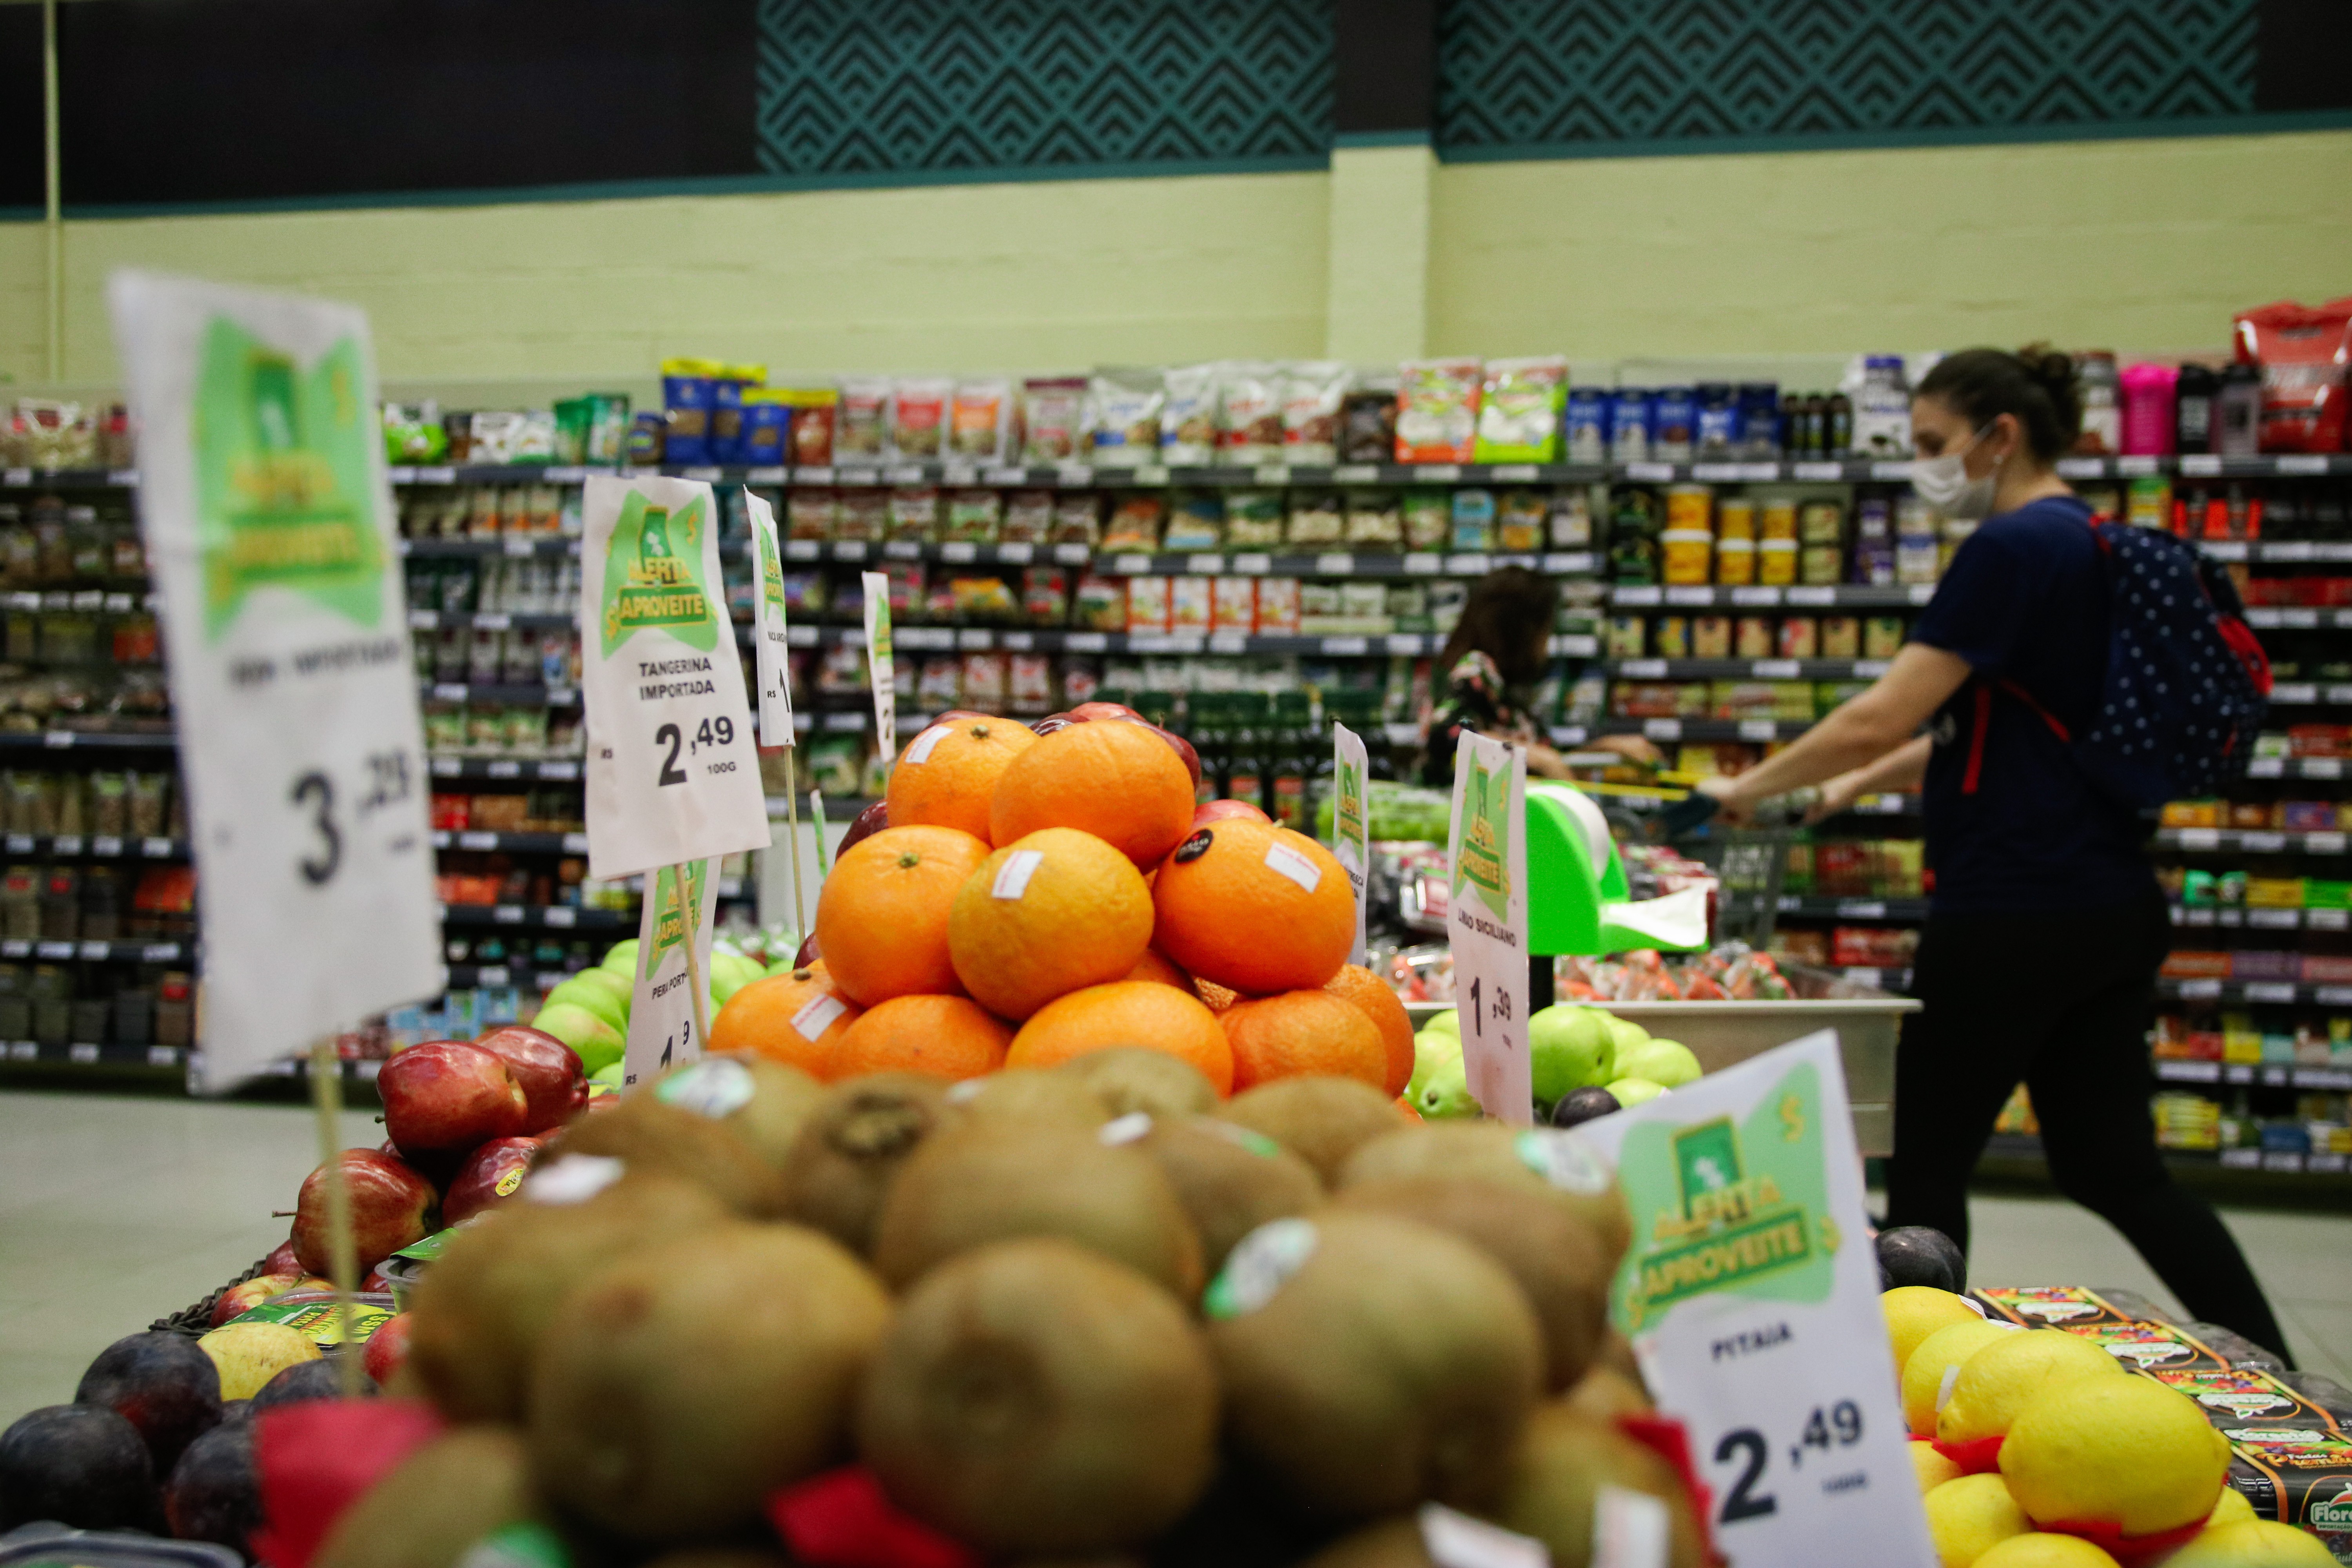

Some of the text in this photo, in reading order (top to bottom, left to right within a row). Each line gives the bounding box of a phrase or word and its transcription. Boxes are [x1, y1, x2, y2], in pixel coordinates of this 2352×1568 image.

[619, 593, 704, 619] APROVEITE
[639, 656, 712, 677] TANGERINA
[639, 679, 715, 701] IMPORTADA
[707, 760, 737, 775] 100G
[1646, 1221, 1803, 1296] APROVEITE
